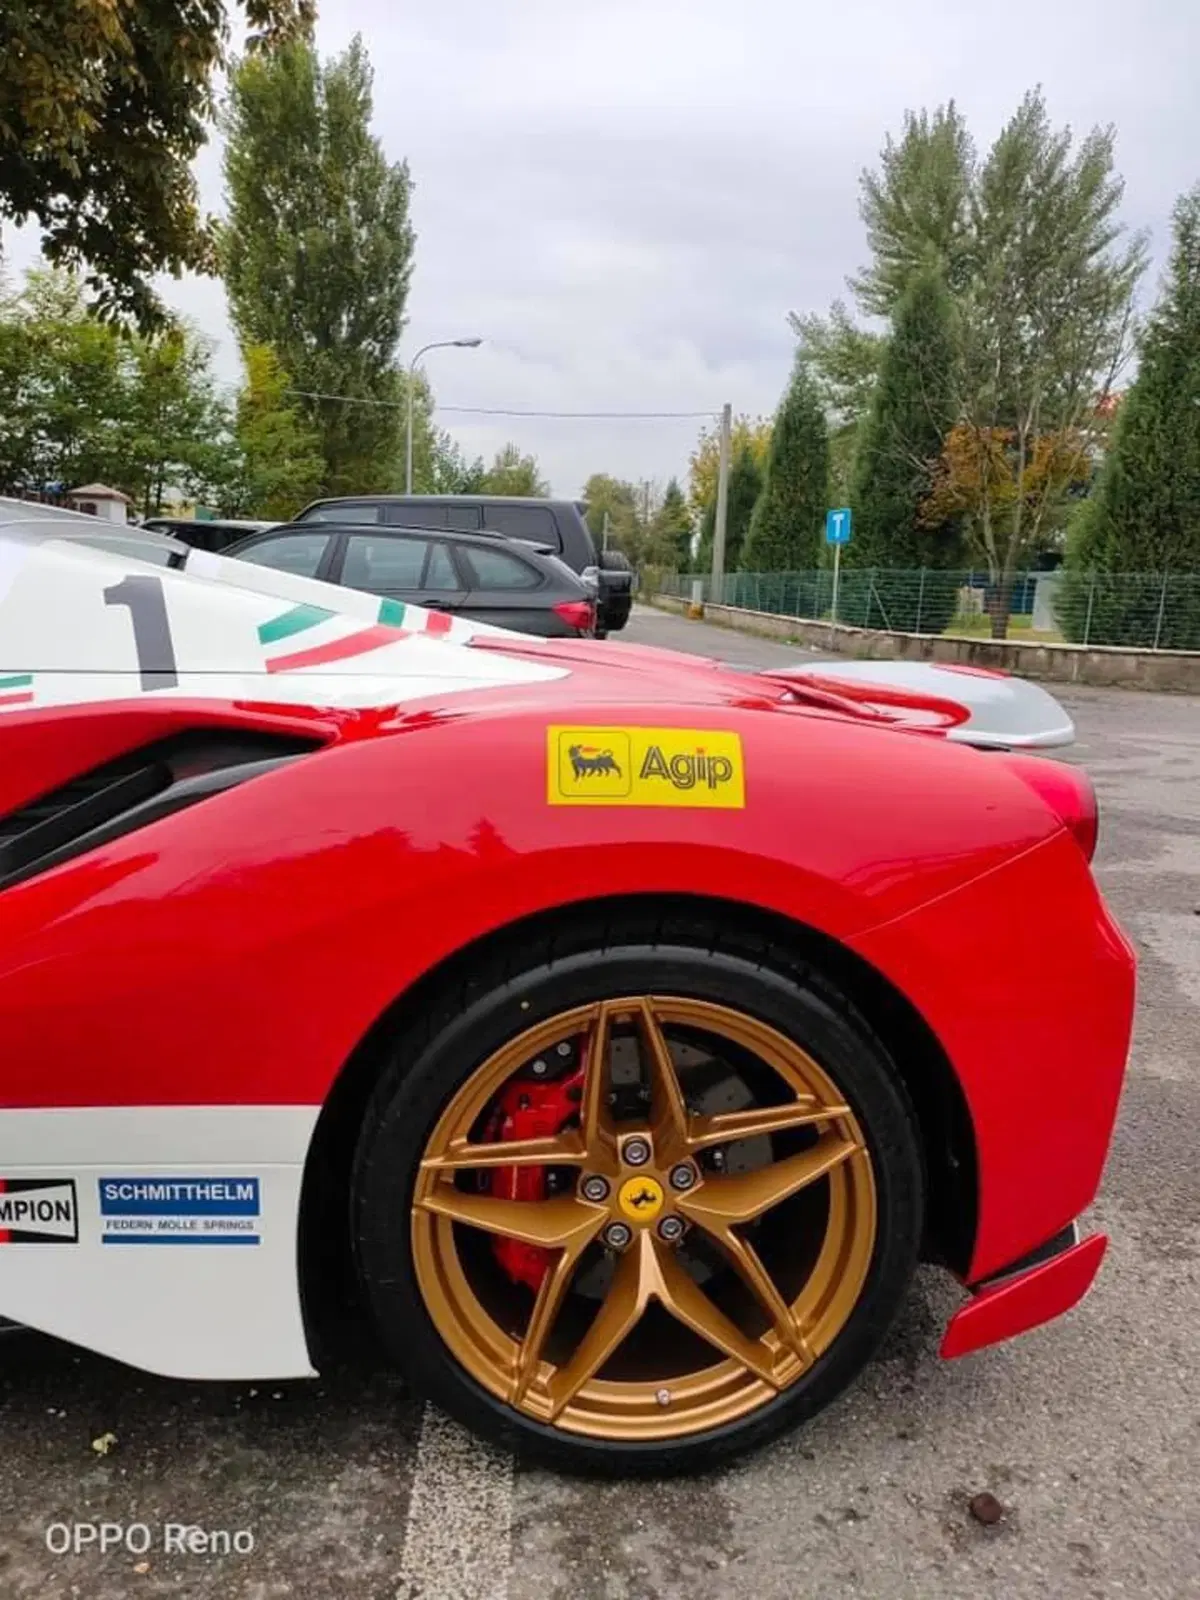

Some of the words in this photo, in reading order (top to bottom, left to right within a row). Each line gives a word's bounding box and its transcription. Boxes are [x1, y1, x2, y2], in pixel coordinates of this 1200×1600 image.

[104, 575, 178, 692] 1
[639, 745, 733, 789] Agip
[105, 1184, 253, 1200] SCHMITTHELM
[106, 1219, 153, 1230] FEDERN
[158, 1219, 197, 1230] MOLLE
[203, 1219, 254, 1230] SPRINGS
